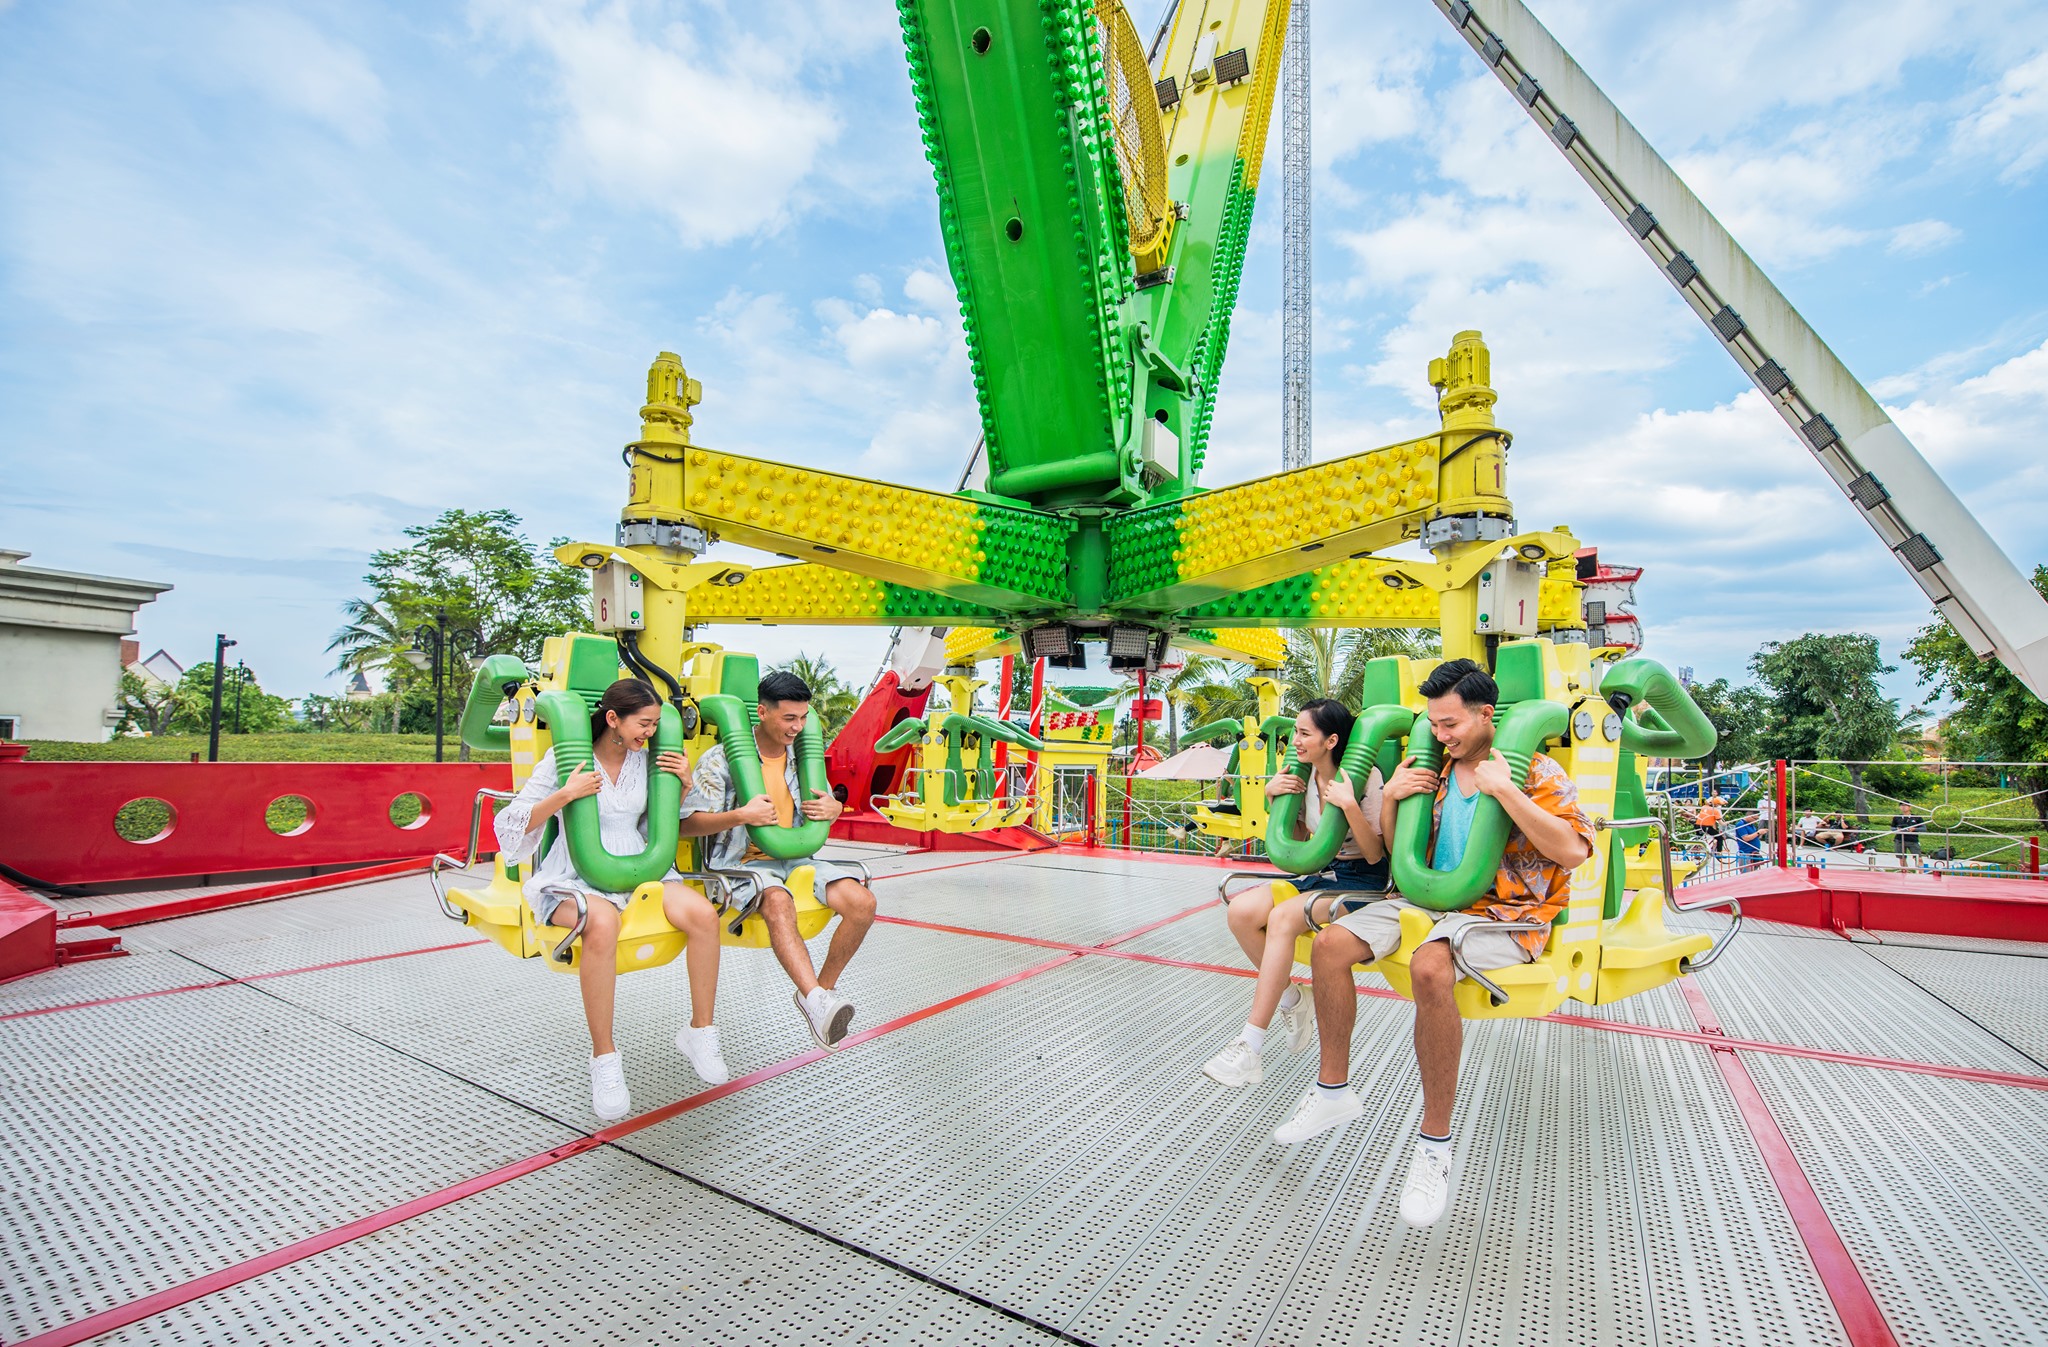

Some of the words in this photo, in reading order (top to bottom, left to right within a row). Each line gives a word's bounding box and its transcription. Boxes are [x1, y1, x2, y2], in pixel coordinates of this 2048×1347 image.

[630, 473, 637, 497] 6
[1493, 463, 1500, 489] 1
[601, 598, 608, 622] 6
[1518, 599, 1525, 626] 1
